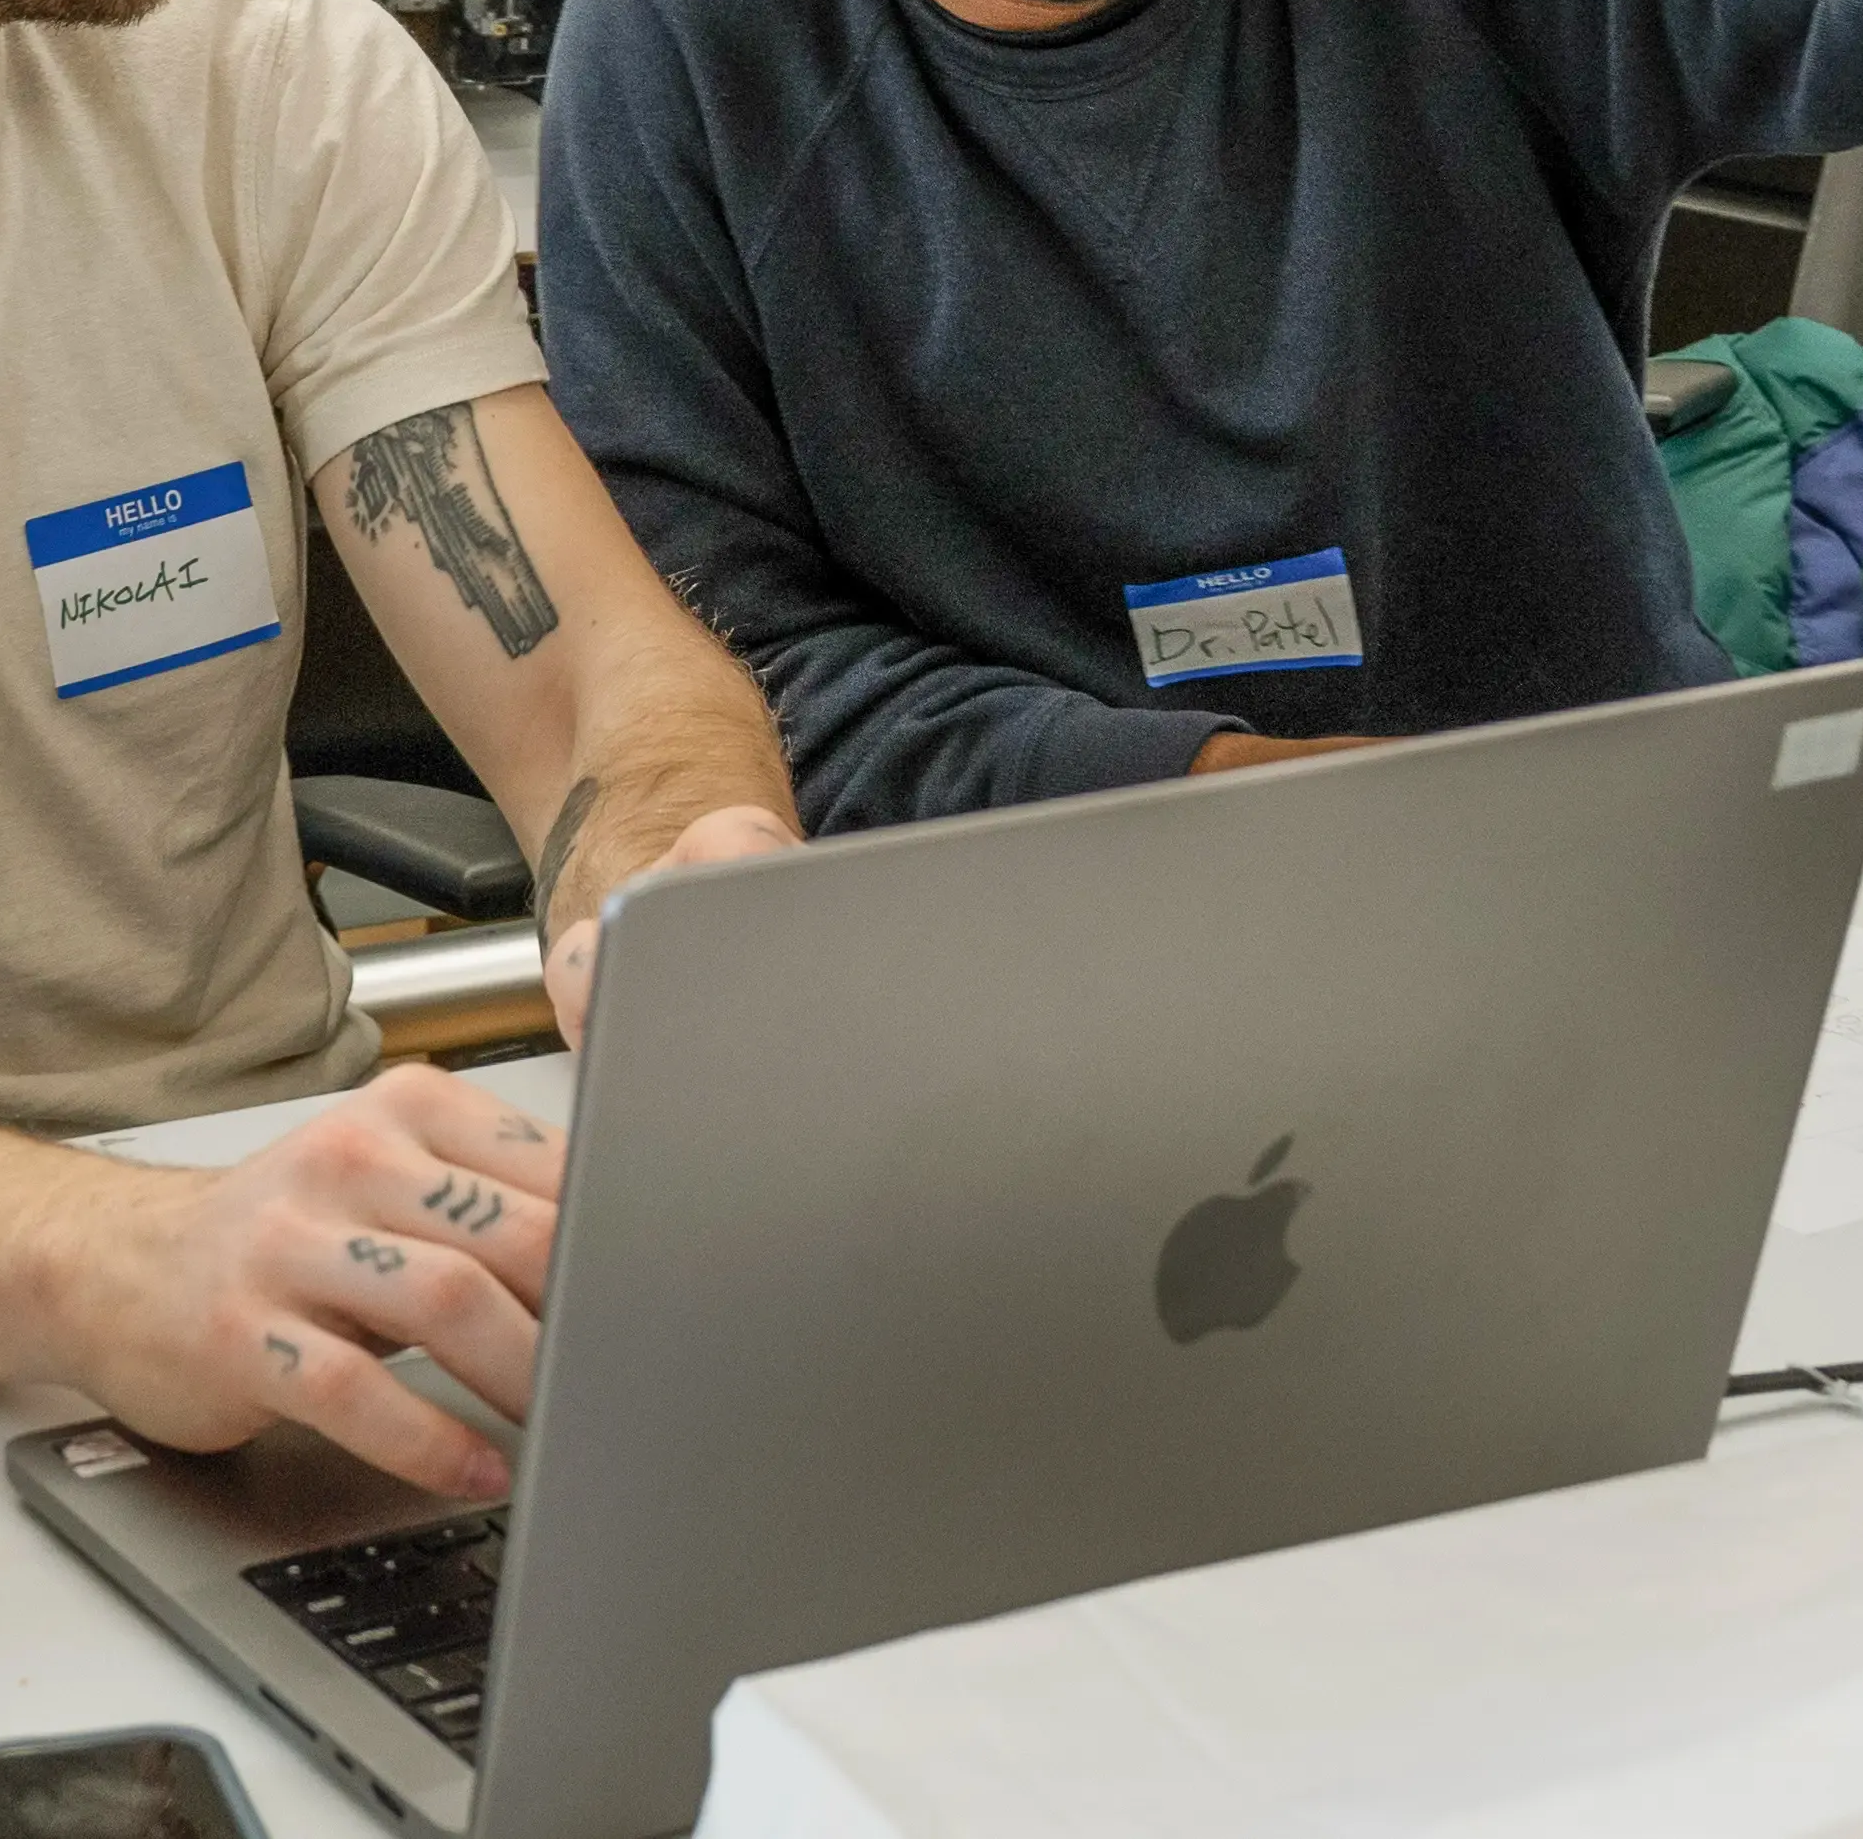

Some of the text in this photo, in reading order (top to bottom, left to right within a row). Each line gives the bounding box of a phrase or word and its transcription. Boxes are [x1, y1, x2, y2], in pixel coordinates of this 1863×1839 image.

[104, 489, 182, 529] HELLO
[119, 526, 134, 537] my
[137, 517, 166, 532] name
[60, 558, 208, 629] NIKOLAI
[1197, 567, 1273, 589] HELLO
[1149, 597, 1338, 664] Dr. Patel
